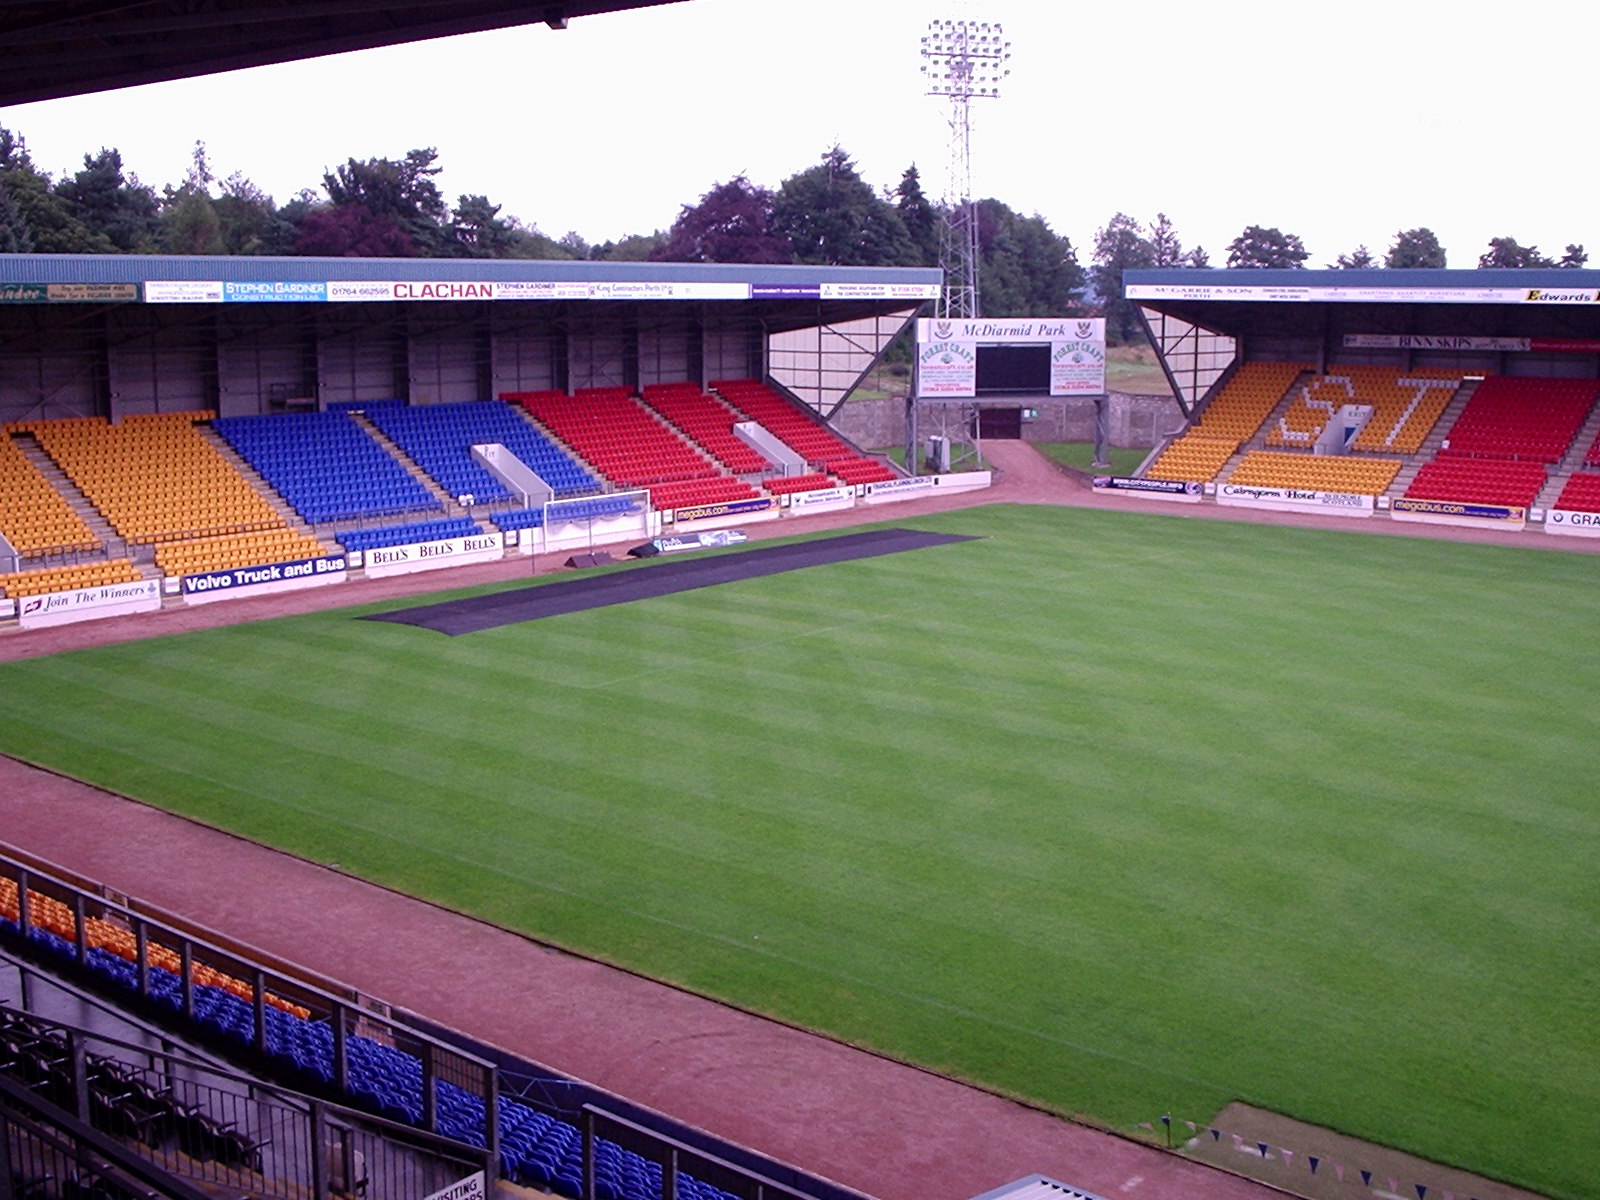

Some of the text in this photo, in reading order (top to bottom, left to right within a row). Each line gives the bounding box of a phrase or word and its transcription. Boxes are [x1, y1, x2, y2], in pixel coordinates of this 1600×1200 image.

[226, 283, 324, 293] STEPHEN GARDNER
[394, 284, 492, 298] CLACHAN
[1526, 289, 1591, 302] Edwards
[961, 324, 1067, 337] McDiarmid Park
[1223, 486, 1316, 500] Cairngorm Hotel
[677, 505, 729, 521] megabus.com
[1394, 500, 1465, 514] megabus.com
[373, 536, 496, 564] BELL'S BELL'S BELL'S
[185, 558, 345, 591] Volvo Truck and Bus
[43, 587, 145, 613] Join The Winners
